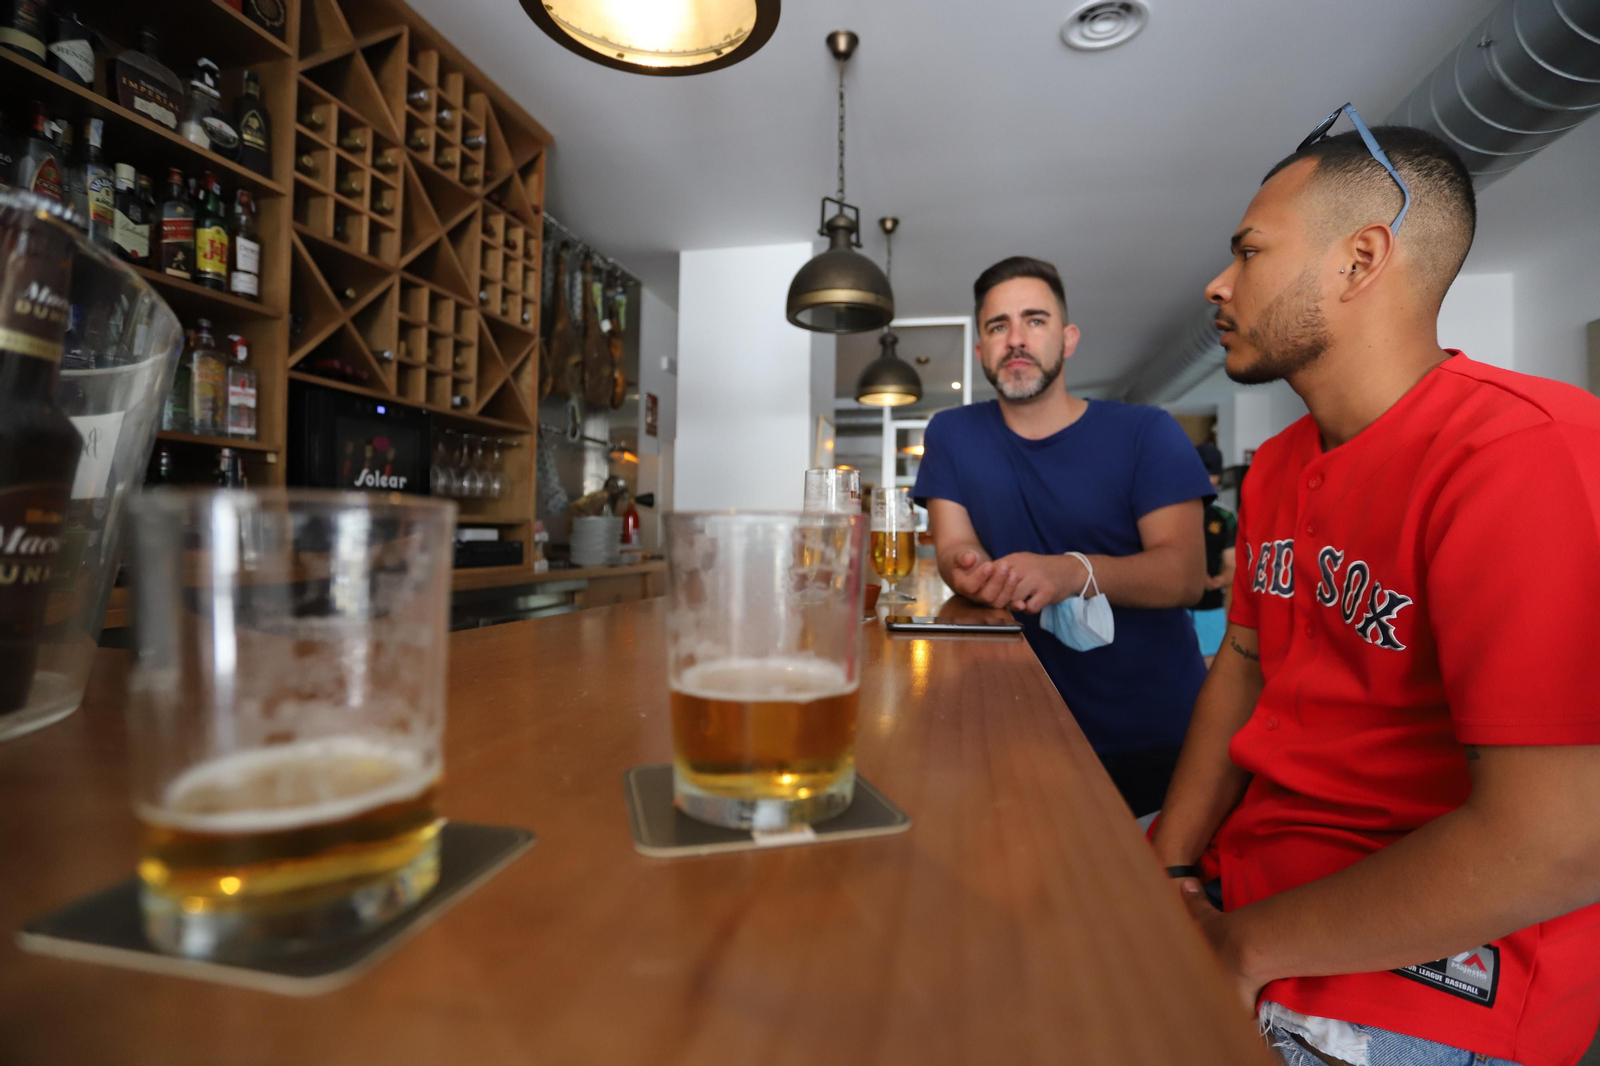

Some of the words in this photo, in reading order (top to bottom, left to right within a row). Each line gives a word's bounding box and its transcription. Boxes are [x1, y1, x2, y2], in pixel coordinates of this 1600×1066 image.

[354, 468, 407, 489] Solear
[1317, 546, 1414, 651] SOX
[1418, 968, 1443, 982] LEAGUE
[1445, 977, 1479, 995] BASEBALL
